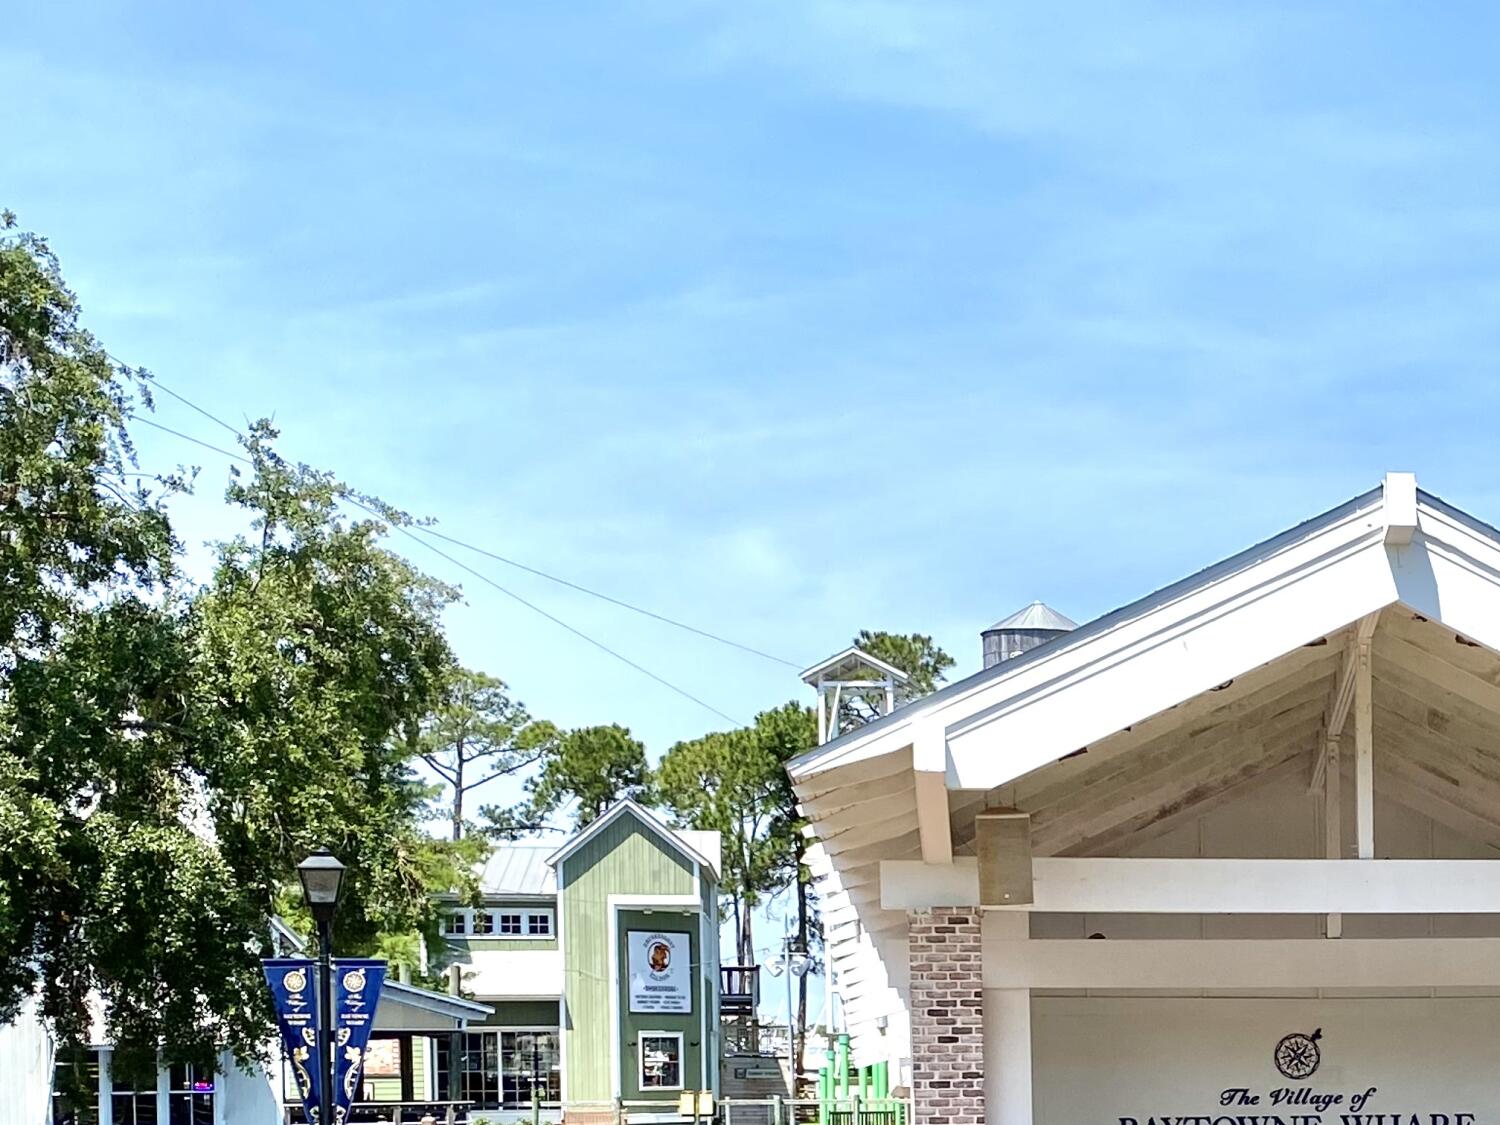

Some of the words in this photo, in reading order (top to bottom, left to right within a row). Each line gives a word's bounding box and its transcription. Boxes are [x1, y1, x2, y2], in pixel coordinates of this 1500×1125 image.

[1220, 1088, 1260, 1106] The
[1269, 1088, 1343, 1113] Village
[1349, 1087, 1377, 1113] of
